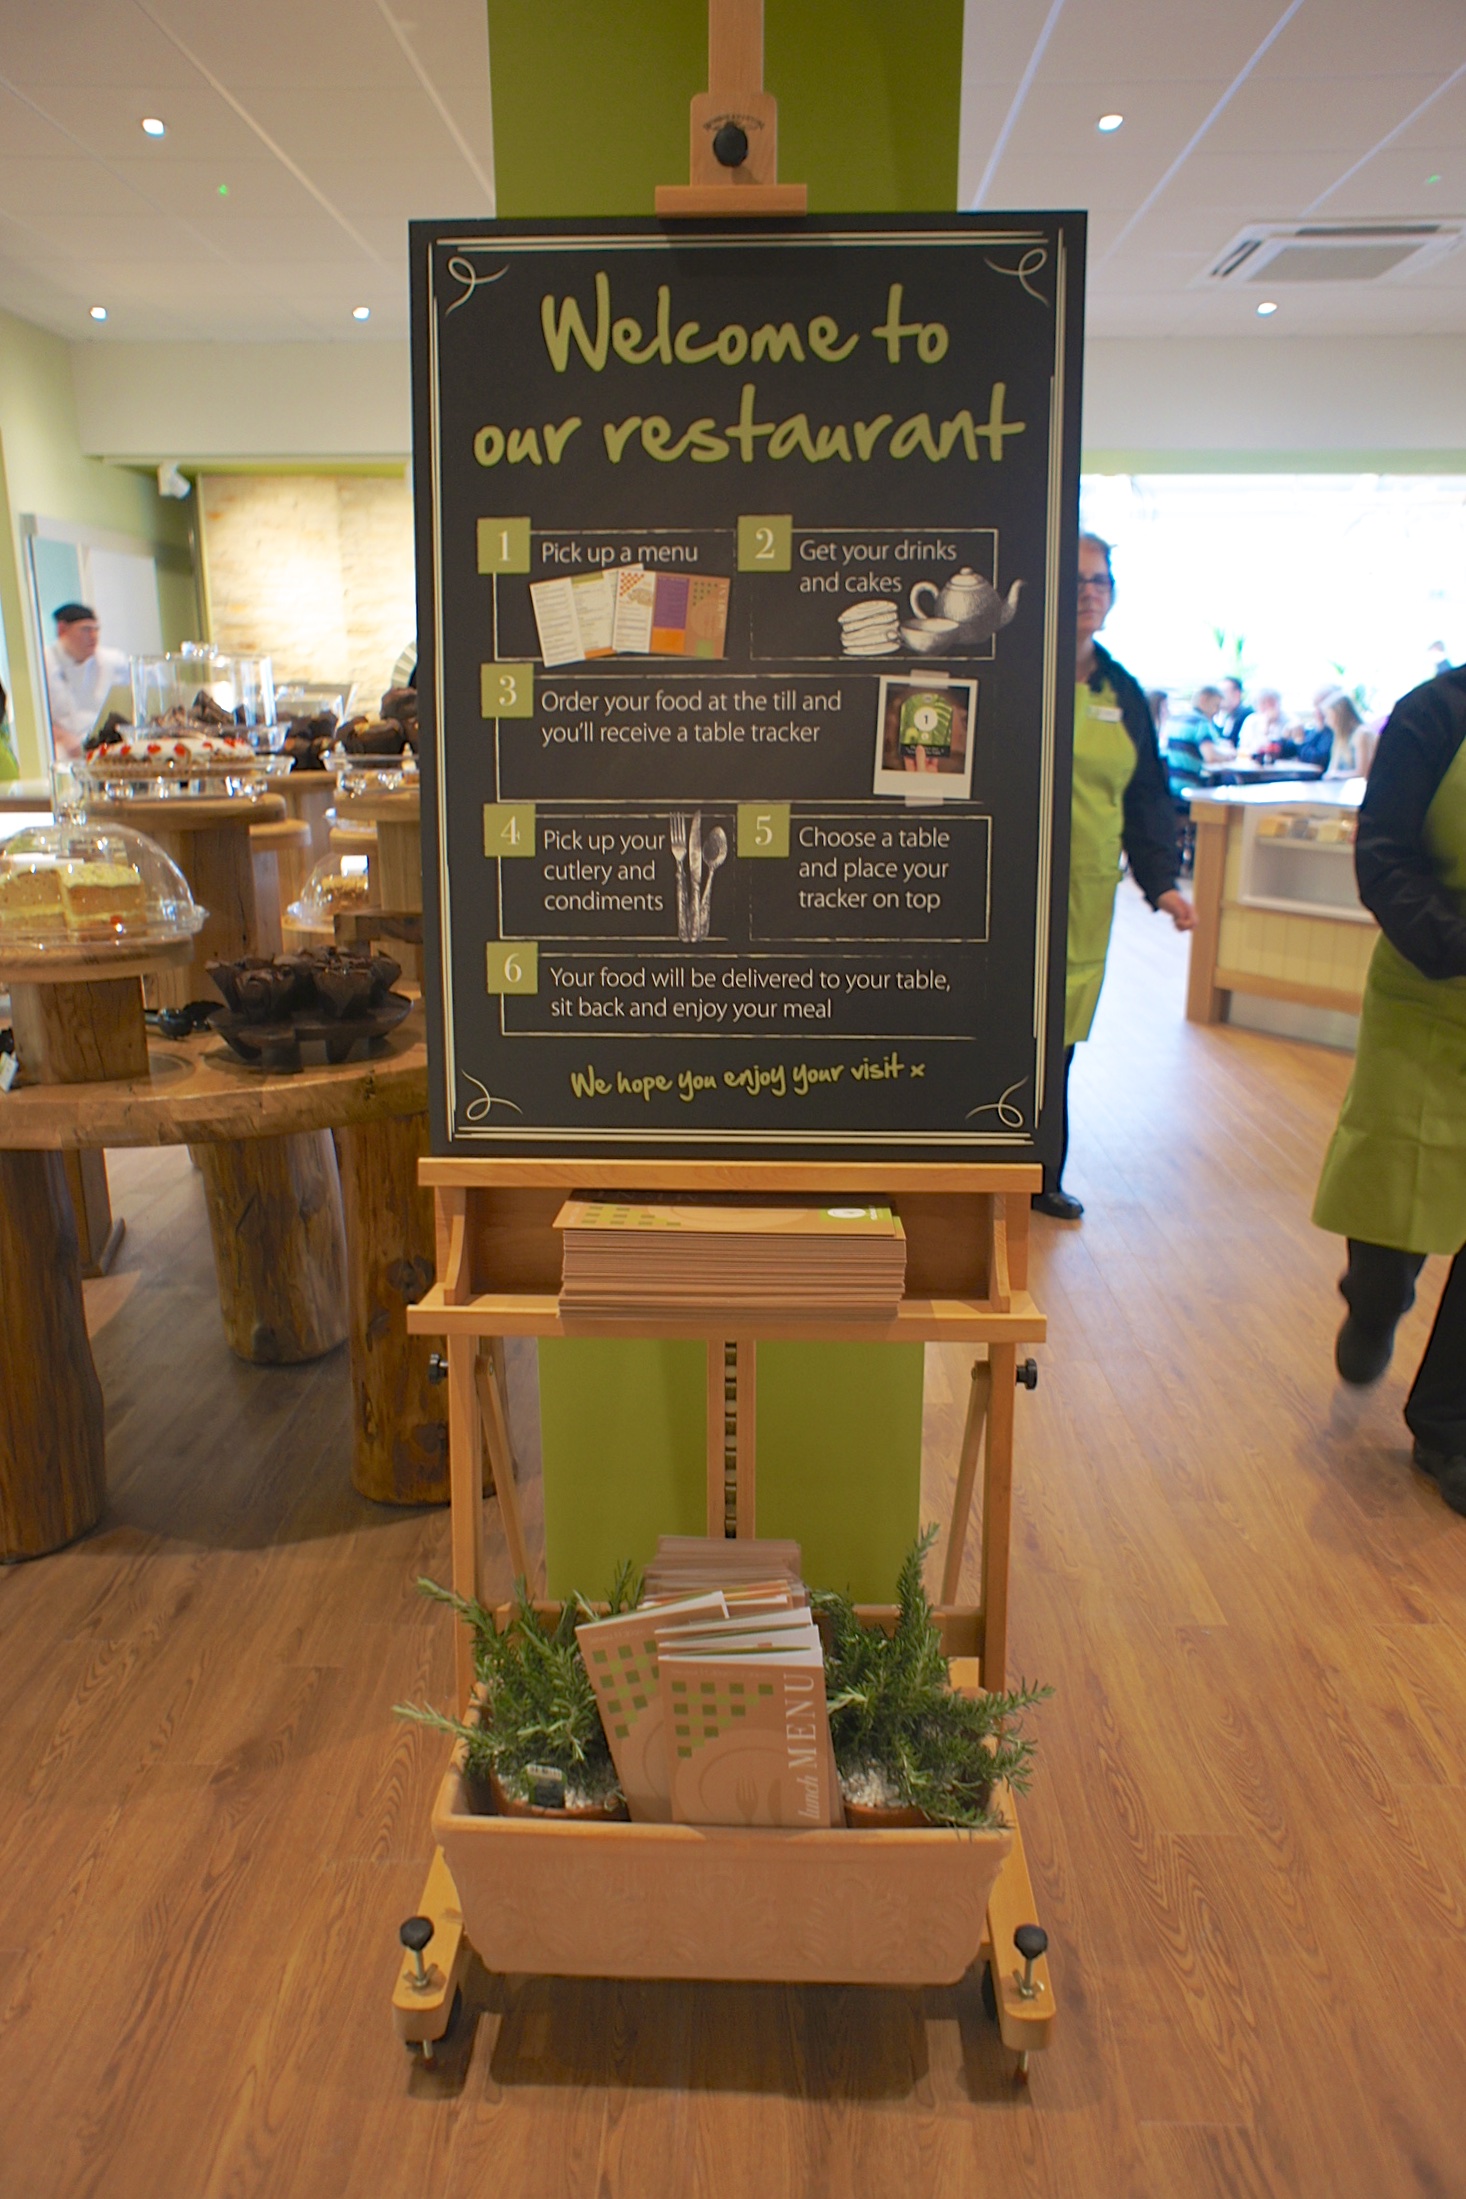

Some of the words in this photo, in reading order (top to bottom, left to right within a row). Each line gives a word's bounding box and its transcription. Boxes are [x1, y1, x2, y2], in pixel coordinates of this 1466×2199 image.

[540, 269, 860, 374] Welcome
[870, 282, 950, 365] to
[473, 416, 583, 468] our
[602, 381, 1027, 465] restaurant
[497, 530, 512, 563] 1
[542, 542, 582, 563] Pick
[587, 546, 615, 568] up
[620, 546, 632, 563] a
[638, 546, 698, 563] menu
[755, 528, 776, 561] 2
[799, 539, 837, 561] Get
[842, 544, 890, 566] your
[894, 539, 957, 561] drinks
[799, 571, 839, 593] and
[844, 571, 902, 593] cakes
[498, 675, 518, 707] 3
[541, 690, 599, 712] Order
[604, 695, 650, 716] your
[655, 689, 702, 711] food
[708, 693, 728, 711] at
[733, 690, 767, 711] the
[773, 690, 796, 711] till
[802, 690, 841, 711] and
[600, 722, 672, 743] receive
[676, 726, 688, 742] a
[694, 721, 745, 742] table
[751, 721, 820, 742] tracker
[500, 815, 521, 846] 4
[544, 829, 583, 850] Pick
[588, 834, 615, 855] up
[619, 834, 665, 855] your
[754, 814, 774, 846] 5
[799, 826, 876, 848] Choose
[881, 832, 893, 847] a
[899, 826, 950, 848] table
[544, 860, 613, 884] cutlery
[617, 859, 655, 881] and
[799, 857, 837, 878] and
[844, 857, 898, 882] place
[903, 863, 949, 883] your
[544, 890, 664, 911] condiments
[799, 887, 868, 908] tracker
[872, 893, 899, 908] on
[905, 891, 941, 913] top
[503, 953, 523, 983] 6
[550, 967, 595, 987] Your
[600, 966, 645, 987] food
[651, 967, 684, 988] will
[691, 967, 716, 988] be
[721, 967, 813, 989] delivered
[819, 970, 839, 989] to
[843, 972, 891, 994] your
[897, 969, 950, 992] table,
[551, 997, 573, 1017] sit
[579, 996, 625, 1017] back
[629, 996, 667, 1017] and
[673, 998, 728, 1022] enjoy
[732, 1003, 778, 1022] your
[783, 998, 831, 1018] meal
[570, 1064, 612, 1099] We
[616, 1071, 673, 1102] hope
[678, 1070, 717, 1102] you
[723, 1064, 786, 1097] enjoy
[792, 1063, 845, 1095] your
[850, 1051, 905, 1080] visit
[910, 1063, 925, 1077] x
[784, 1672, 817, 1769] MENU
[797, 1775, 820, 1820] lunch
